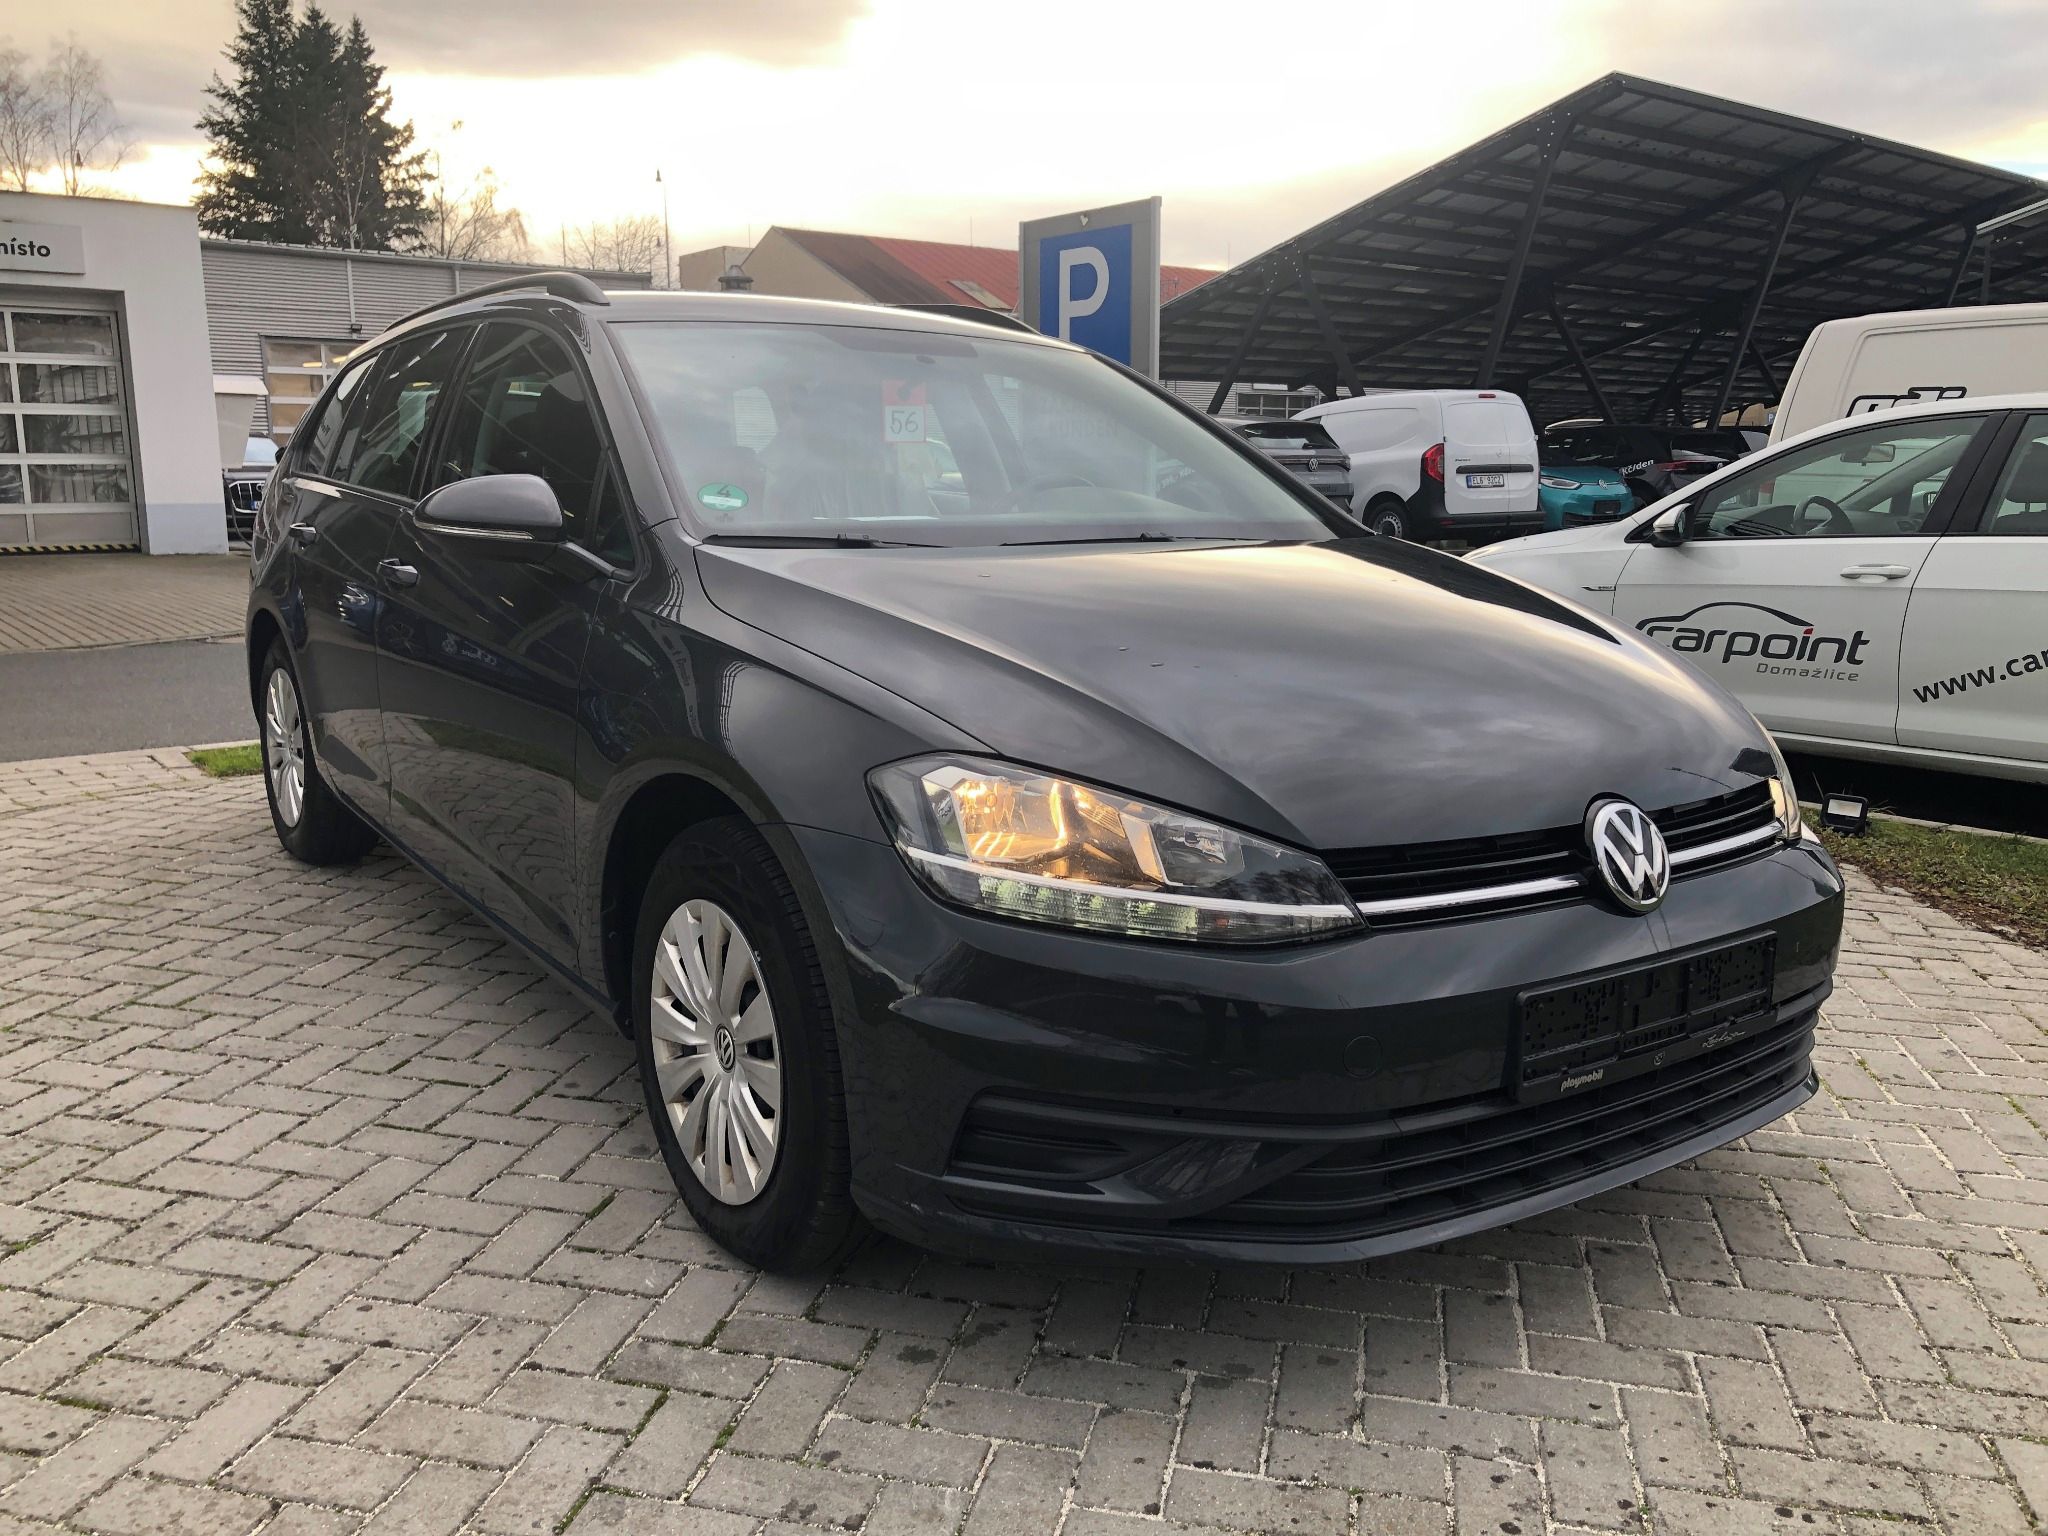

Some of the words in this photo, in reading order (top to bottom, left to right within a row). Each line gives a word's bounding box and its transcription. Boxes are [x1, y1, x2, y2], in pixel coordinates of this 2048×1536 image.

[1060, 247, 1109, 342] P
[890, 410, 919, 434] 56
[1756, 663, 1859, 682] Domažlice
[1560, 1069, 1603, 1092] playmobil
